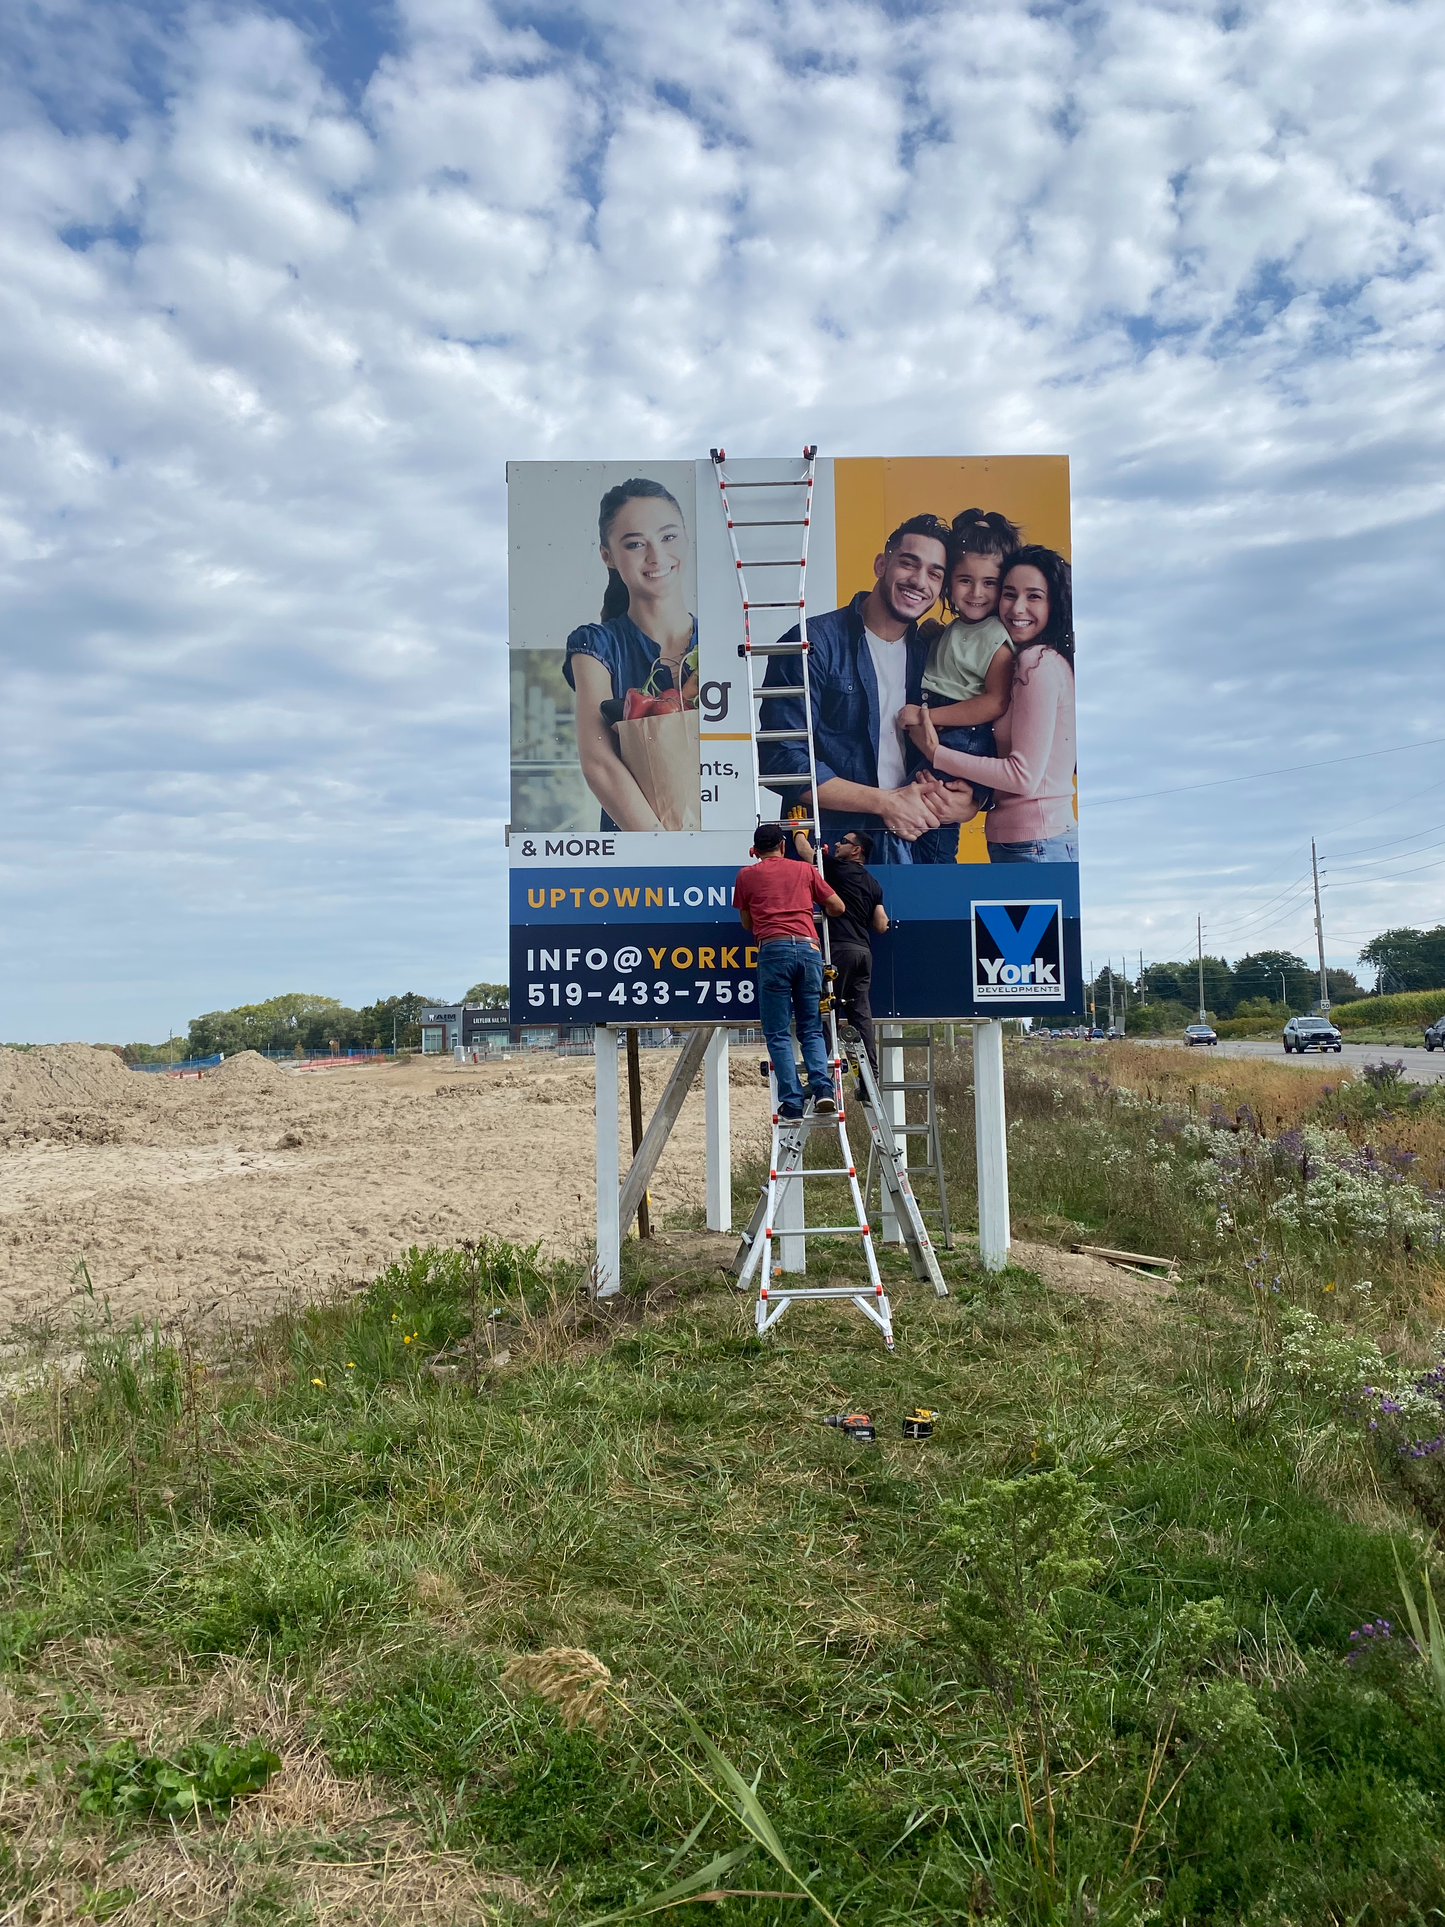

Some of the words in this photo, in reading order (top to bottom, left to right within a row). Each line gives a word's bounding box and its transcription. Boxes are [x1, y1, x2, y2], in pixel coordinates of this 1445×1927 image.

[521, 840, 537, 857] &
[545, 839, 616, 857] MORE
[527, 886, 736, 908] UPTOWNLON
[979, 958, 1057, 984] York
